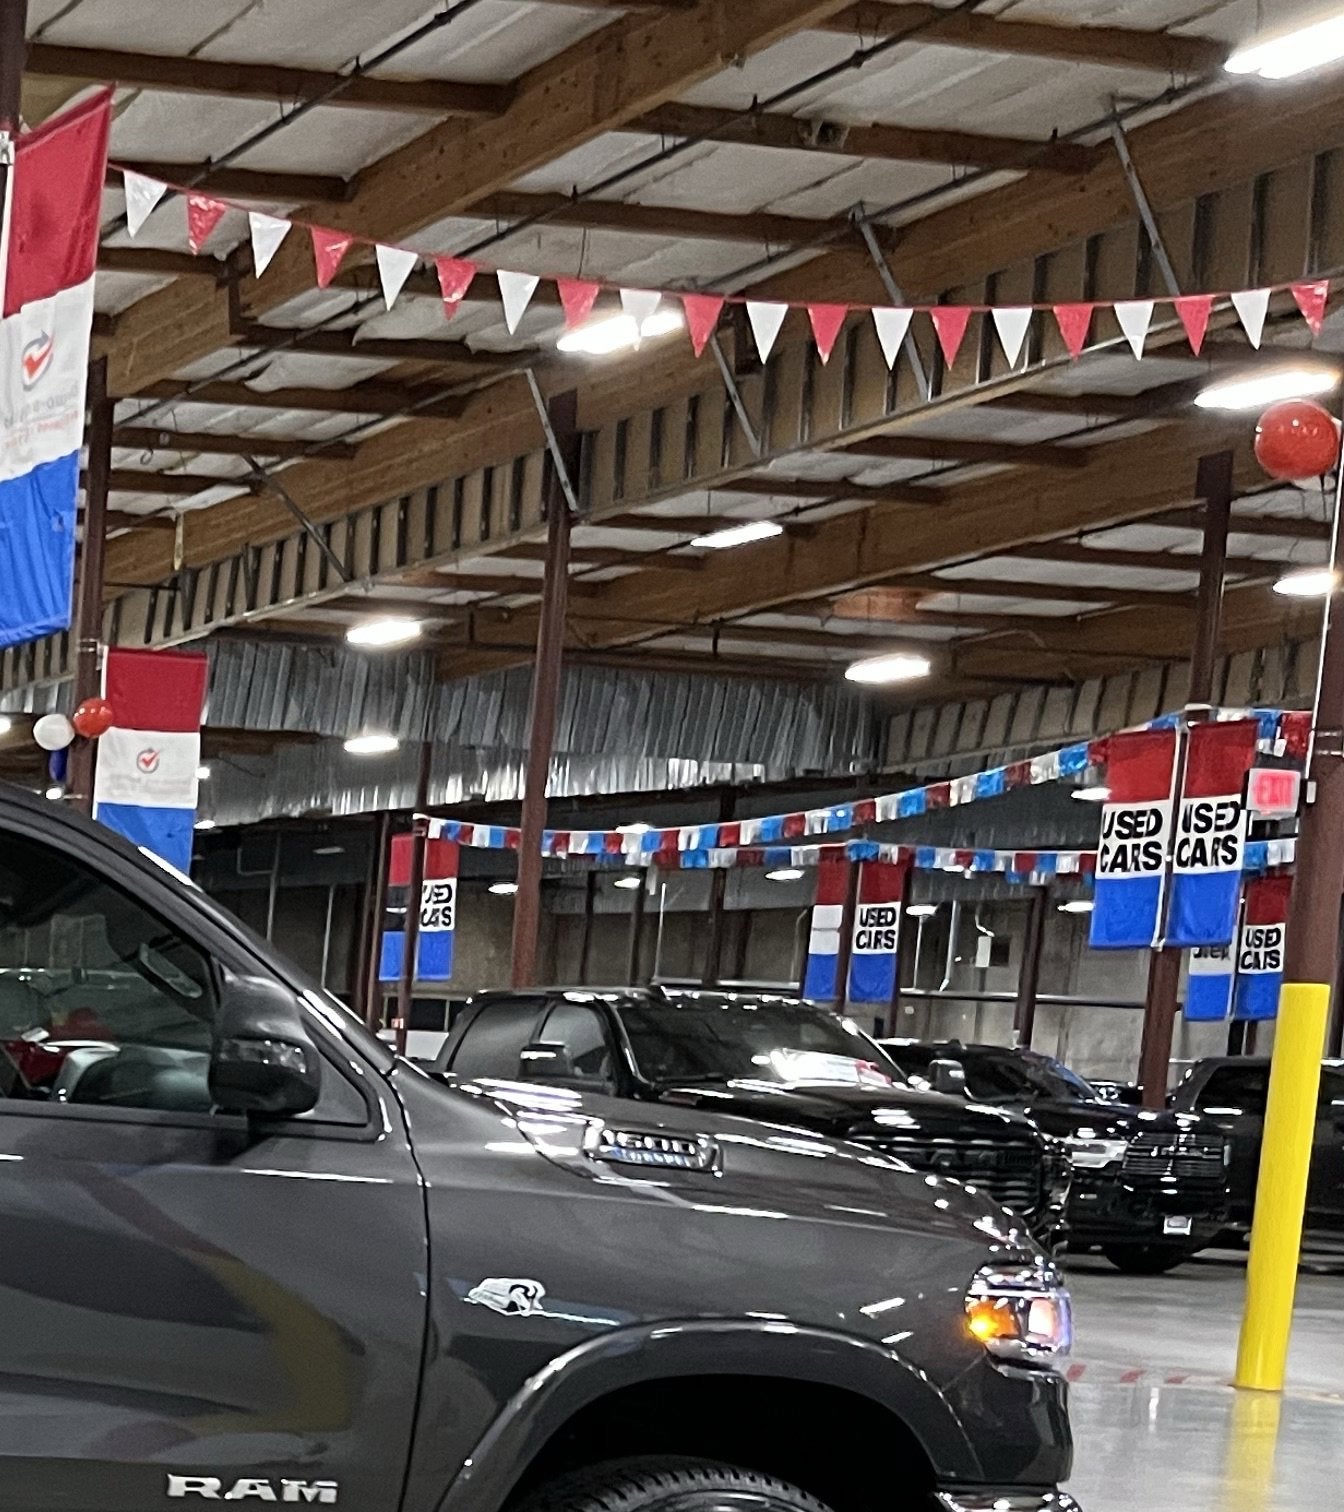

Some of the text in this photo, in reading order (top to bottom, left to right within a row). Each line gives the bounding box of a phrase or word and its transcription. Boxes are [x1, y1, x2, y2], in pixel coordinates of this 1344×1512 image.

[1102, 808, 1163, 840] USED
[1181, 801, 1241, 834] USED
[1100, 841, 1162, 873] CARS
[1176, 834, 1238, 868] CARS
[422, 884, 453, 904] UED
[859, 907, 897, 927] USED
[1245, 927, 1281, 948] USED
[167, 1473, 338, 1503] RAM
